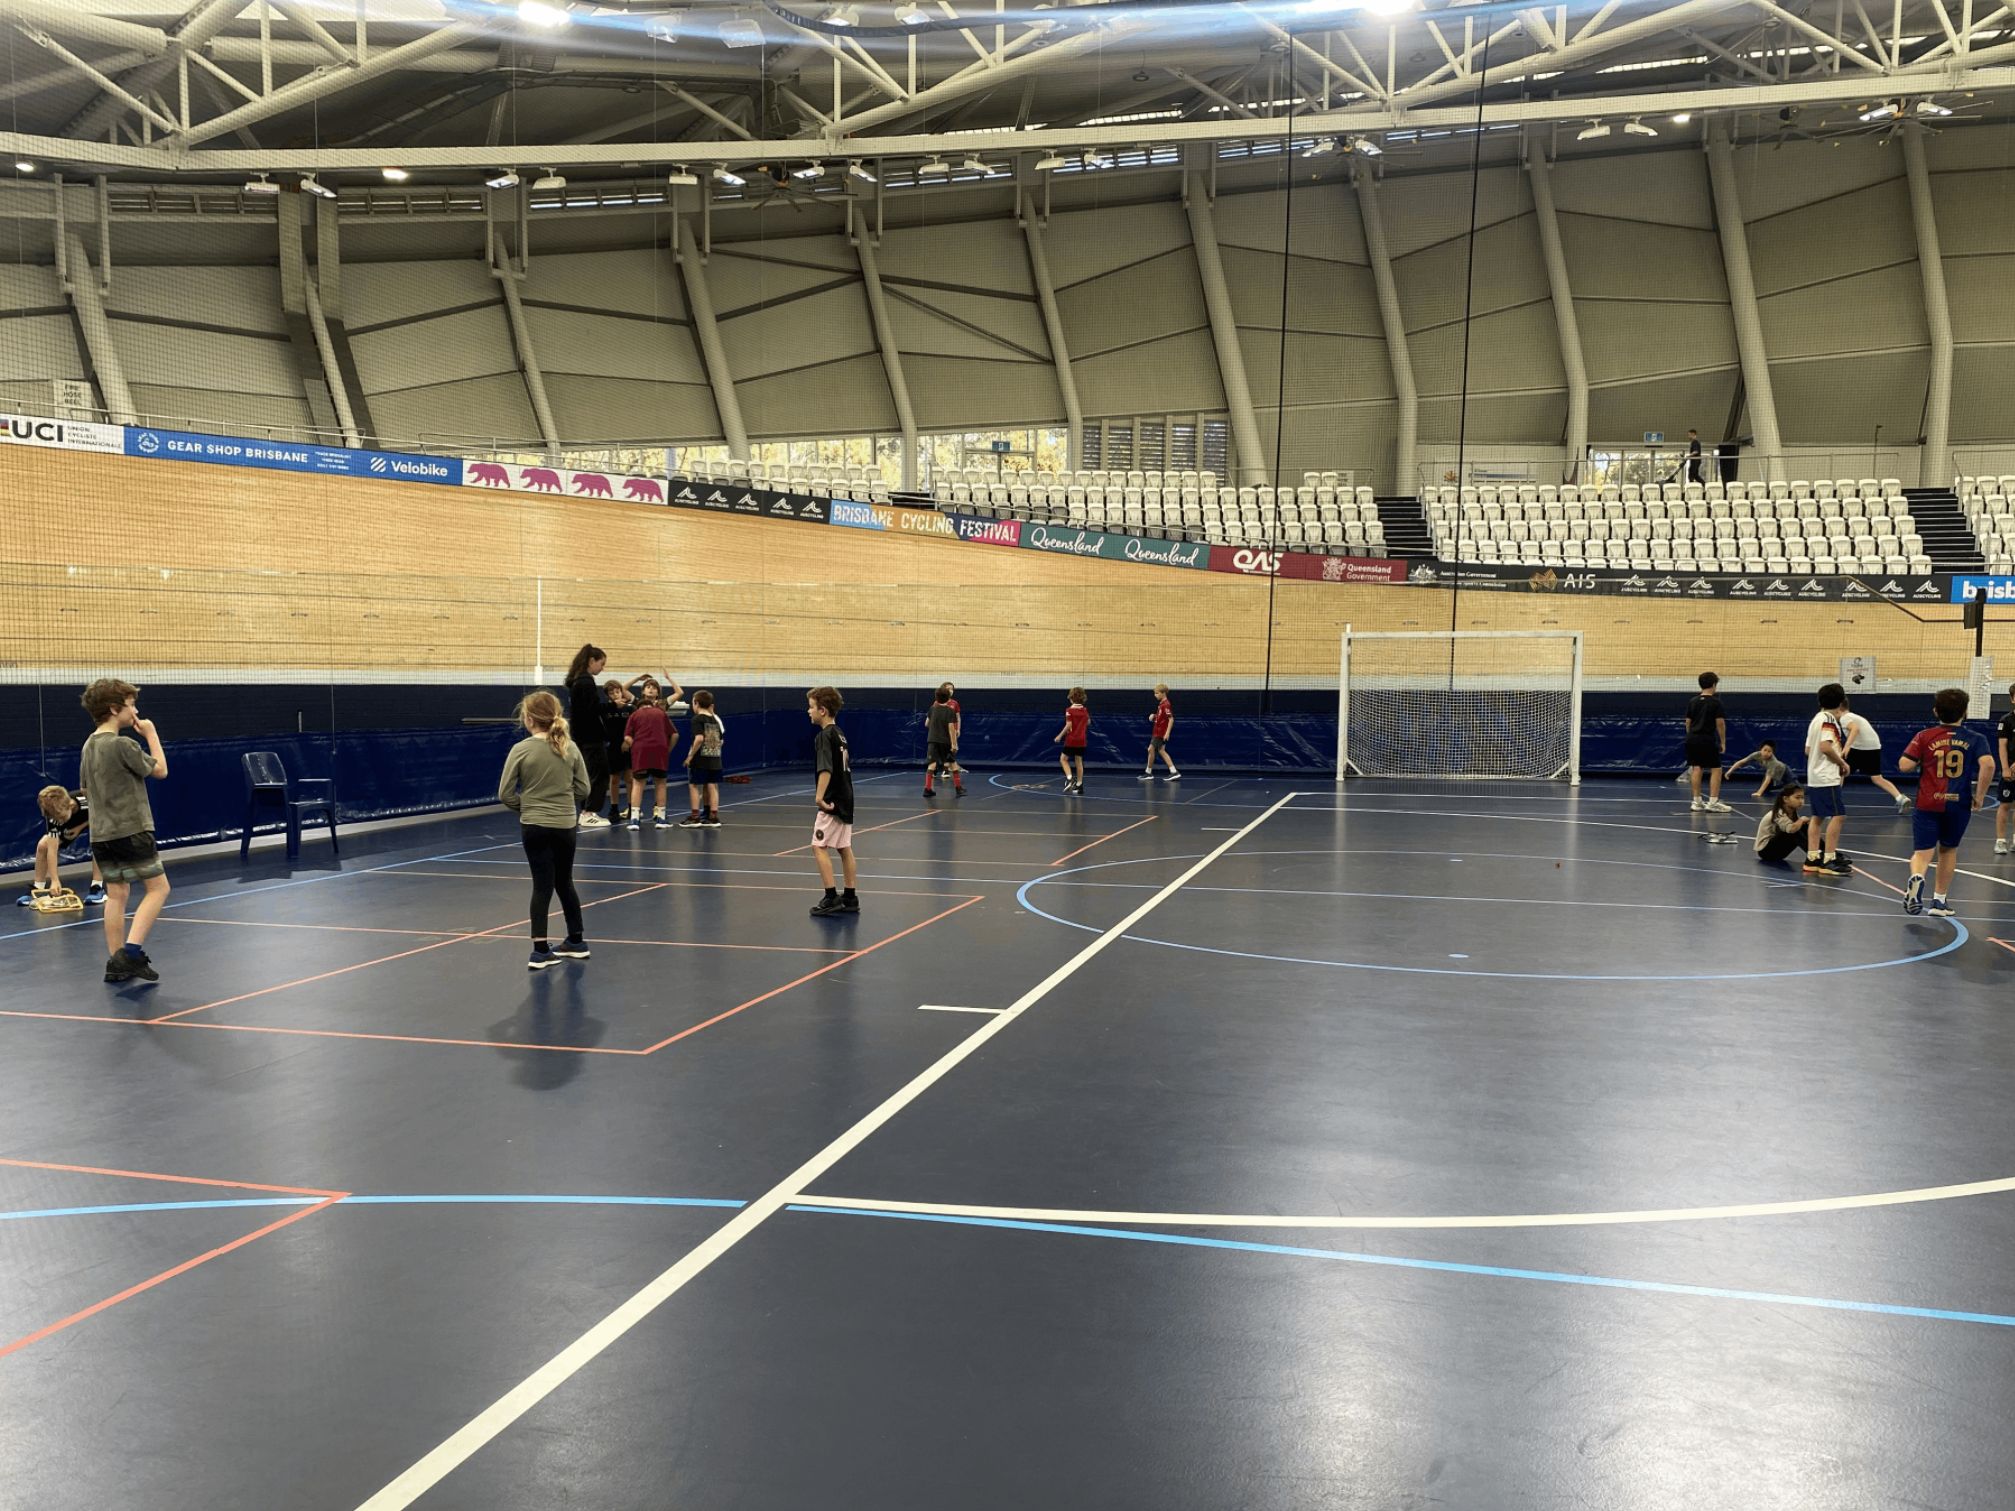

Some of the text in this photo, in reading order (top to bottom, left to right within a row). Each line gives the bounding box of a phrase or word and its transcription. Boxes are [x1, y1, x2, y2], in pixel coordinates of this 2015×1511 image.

[12, 420, 64, 442] UCI
[167, 440, 203, 453] GEAR
[207, 444, 242, 456] SHOP
[245, 448, 308, 463] BRISBANE
[391, 460, 449, 477] Velobike
[833, 504, 1017, 542] BRISBANE CYCLING FESTIVAL
[1030, 527, 1105, 555] Queensland
[1124, 538, 1200, 566] Queensland
[1233, 549, 1284, 573] QAS
[1347, 563, 1392, 574] Queensland
[1346, 573, 1391, 582] Government
[1564, 573, 1596, 589] AIS
[1933, 749, 1964, 778] 19
